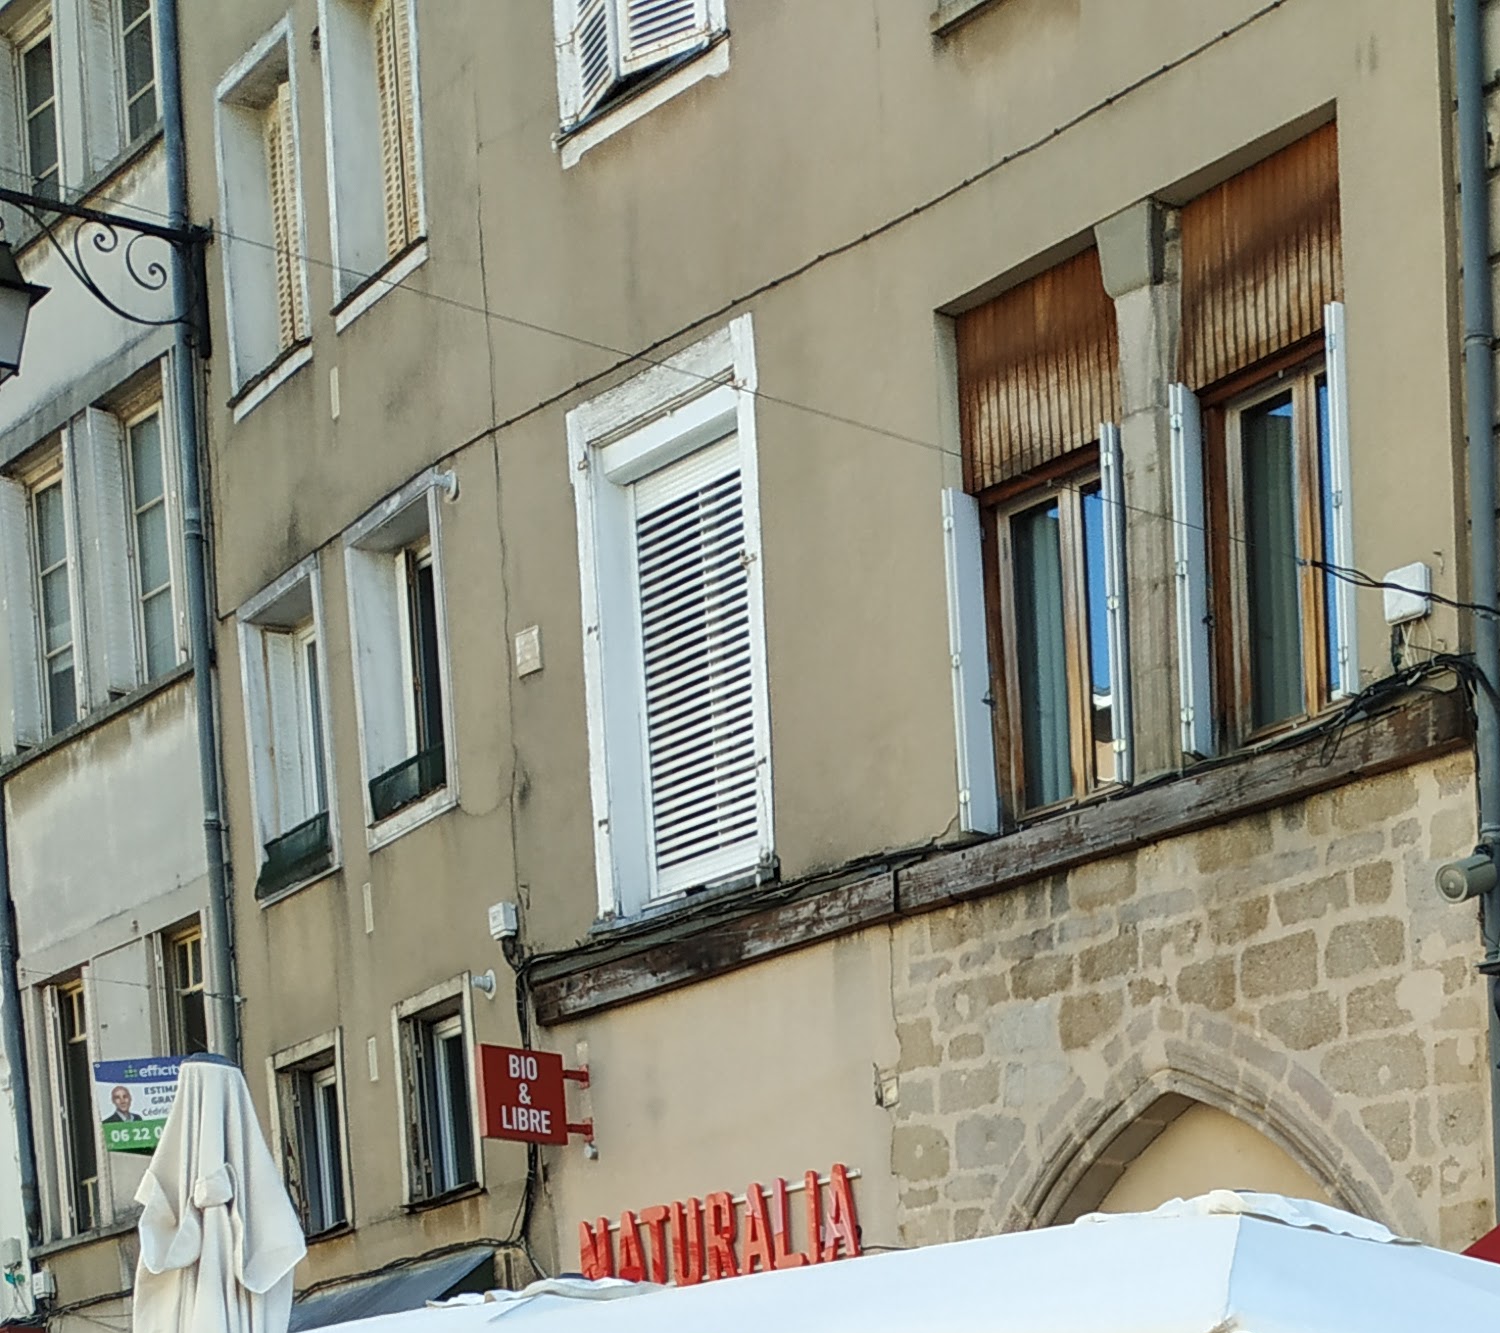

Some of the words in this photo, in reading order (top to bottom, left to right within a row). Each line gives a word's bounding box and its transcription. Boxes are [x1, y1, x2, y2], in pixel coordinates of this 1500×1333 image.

[508, 1054, 538, 1080] BIO
[518, 1083, 531, 1105] &
[501, 1105, 552, 1134] LIBRE
[111, 1129, 130, 1142] 06
[133, 1127, 151, 1141] 22
[579, 1163, 861, 1287] NATURALIA
